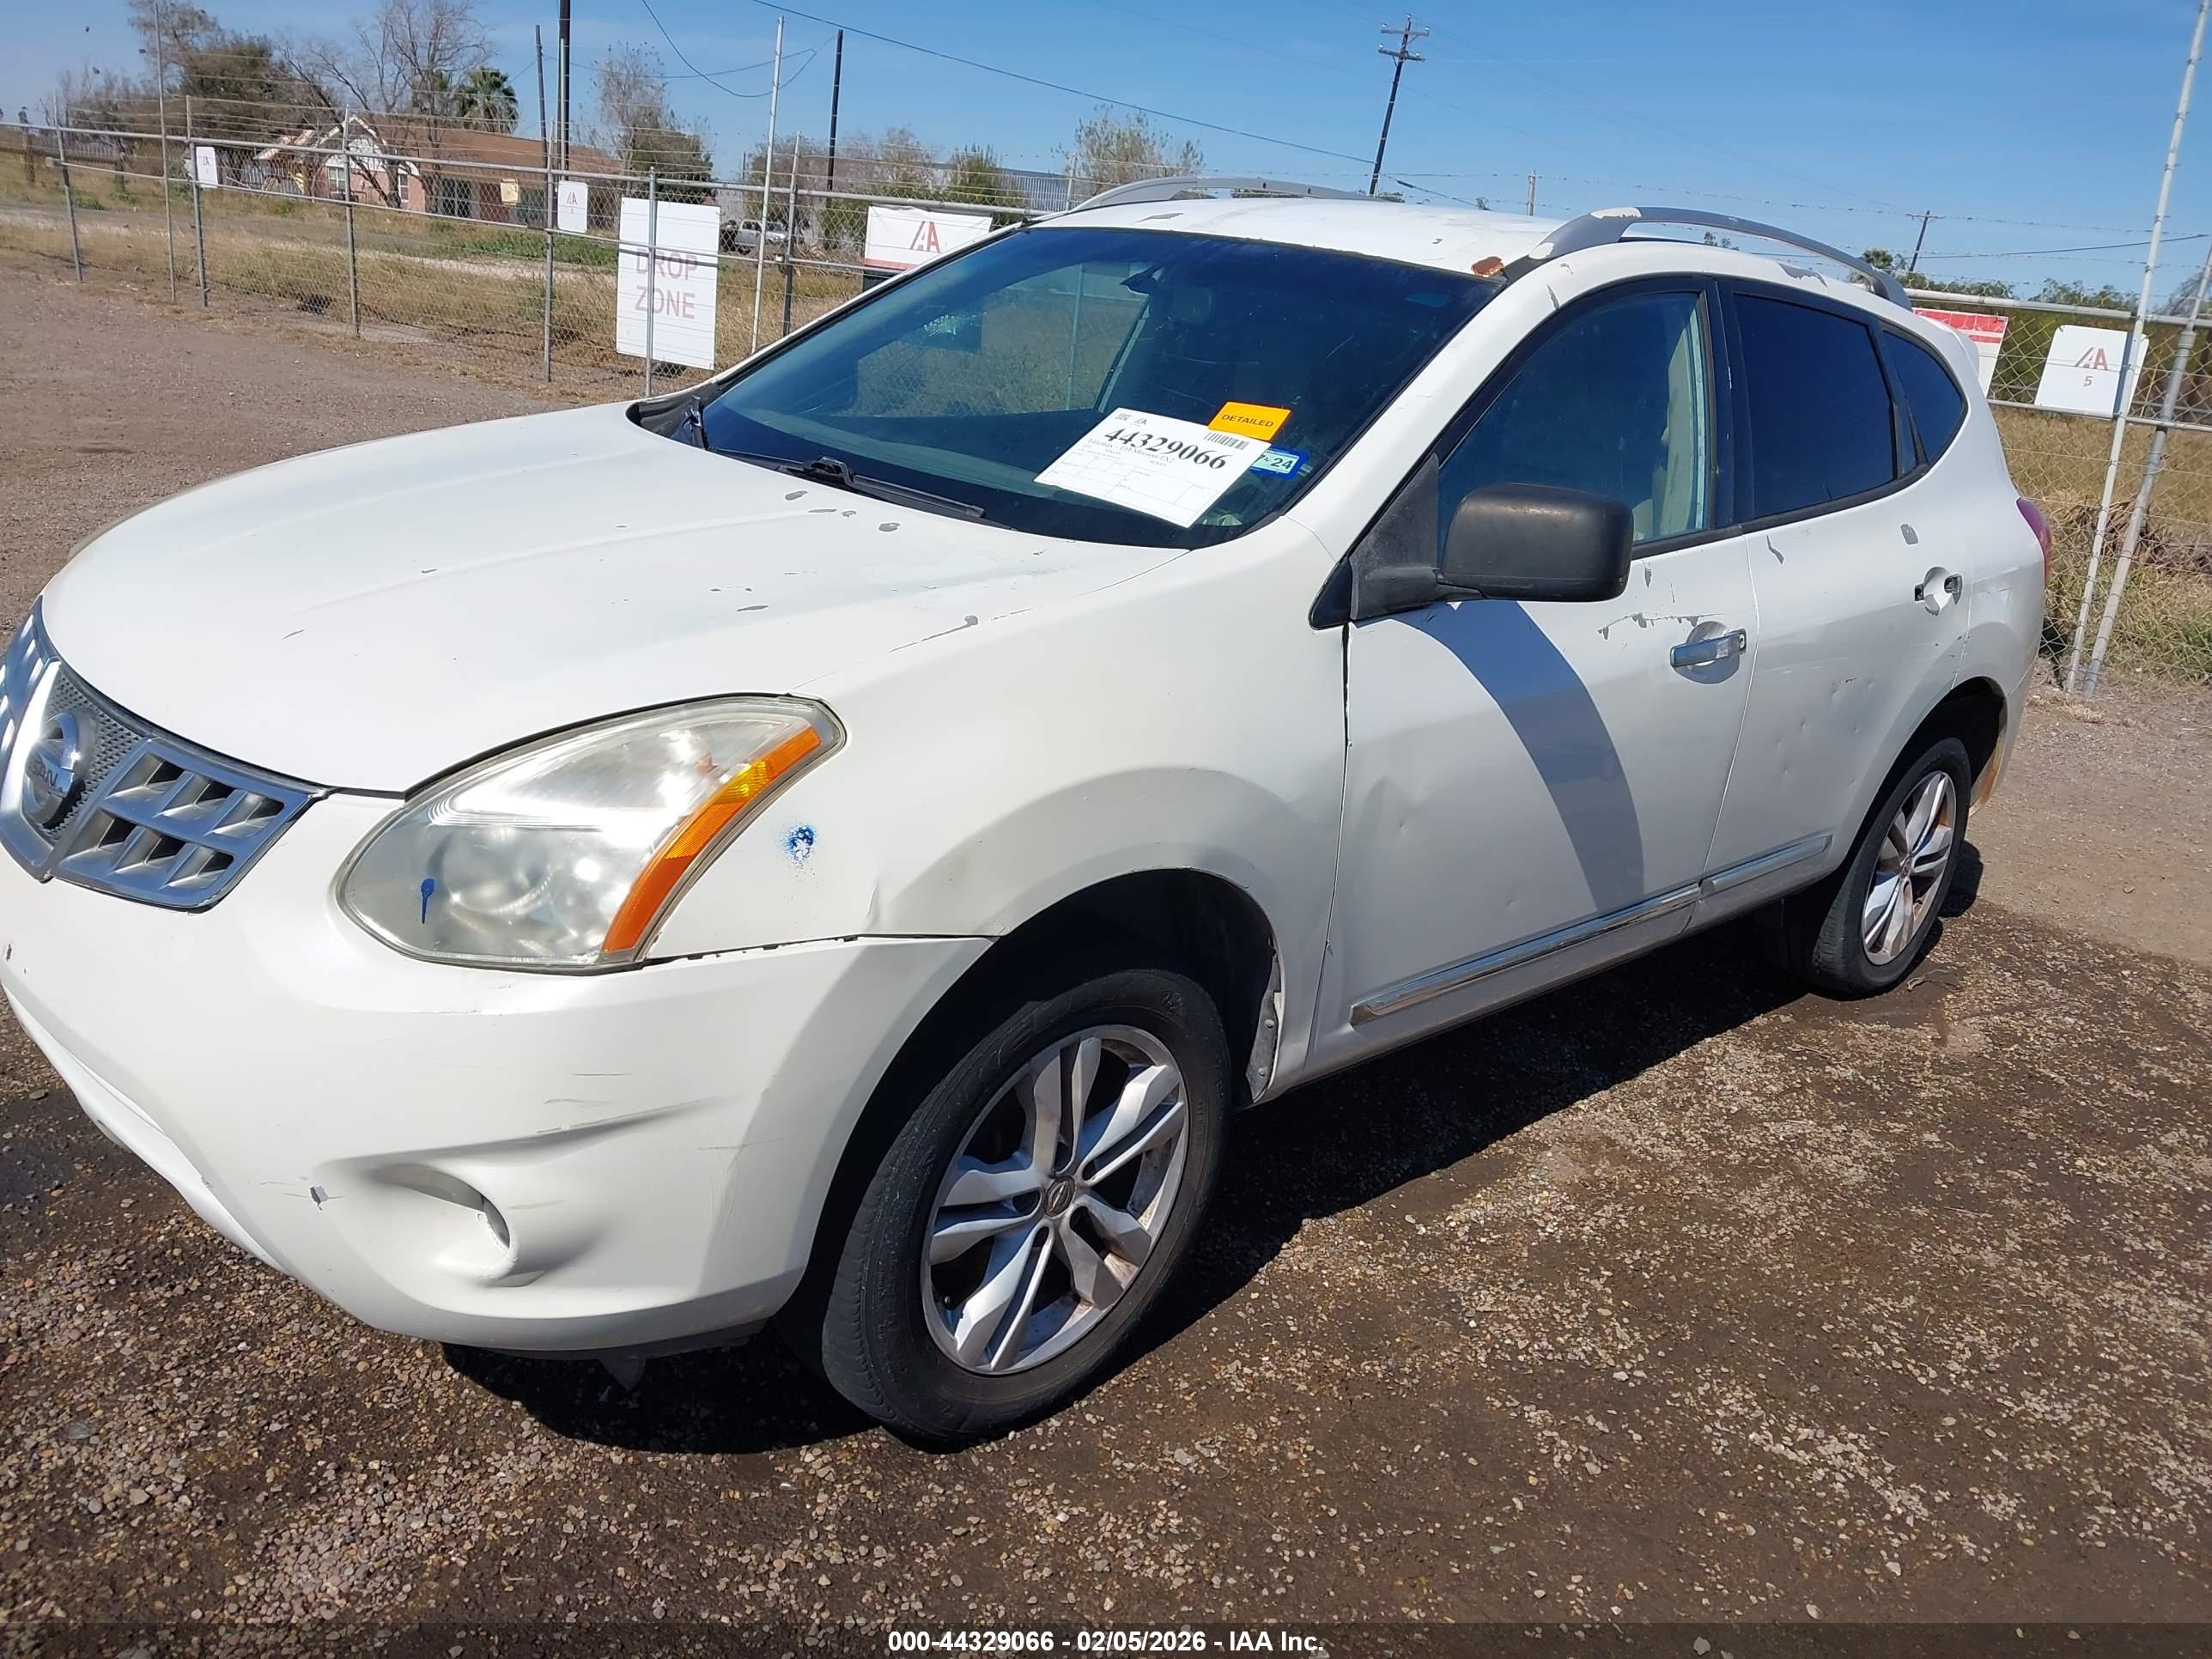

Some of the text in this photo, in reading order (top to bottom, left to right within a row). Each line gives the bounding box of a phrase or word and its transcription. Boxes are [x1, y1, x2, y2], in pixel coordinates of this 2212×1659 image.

[635, 248, 698, 281] DROP
[635, 285, 696, 319] ZONE
[2083, 375, 2094, 387] 5
[1221, 414, 1274, 428] DETAILED
[1104, 428, 1232, 469] 44329066
[1270, 457, 1293, 470] 24
